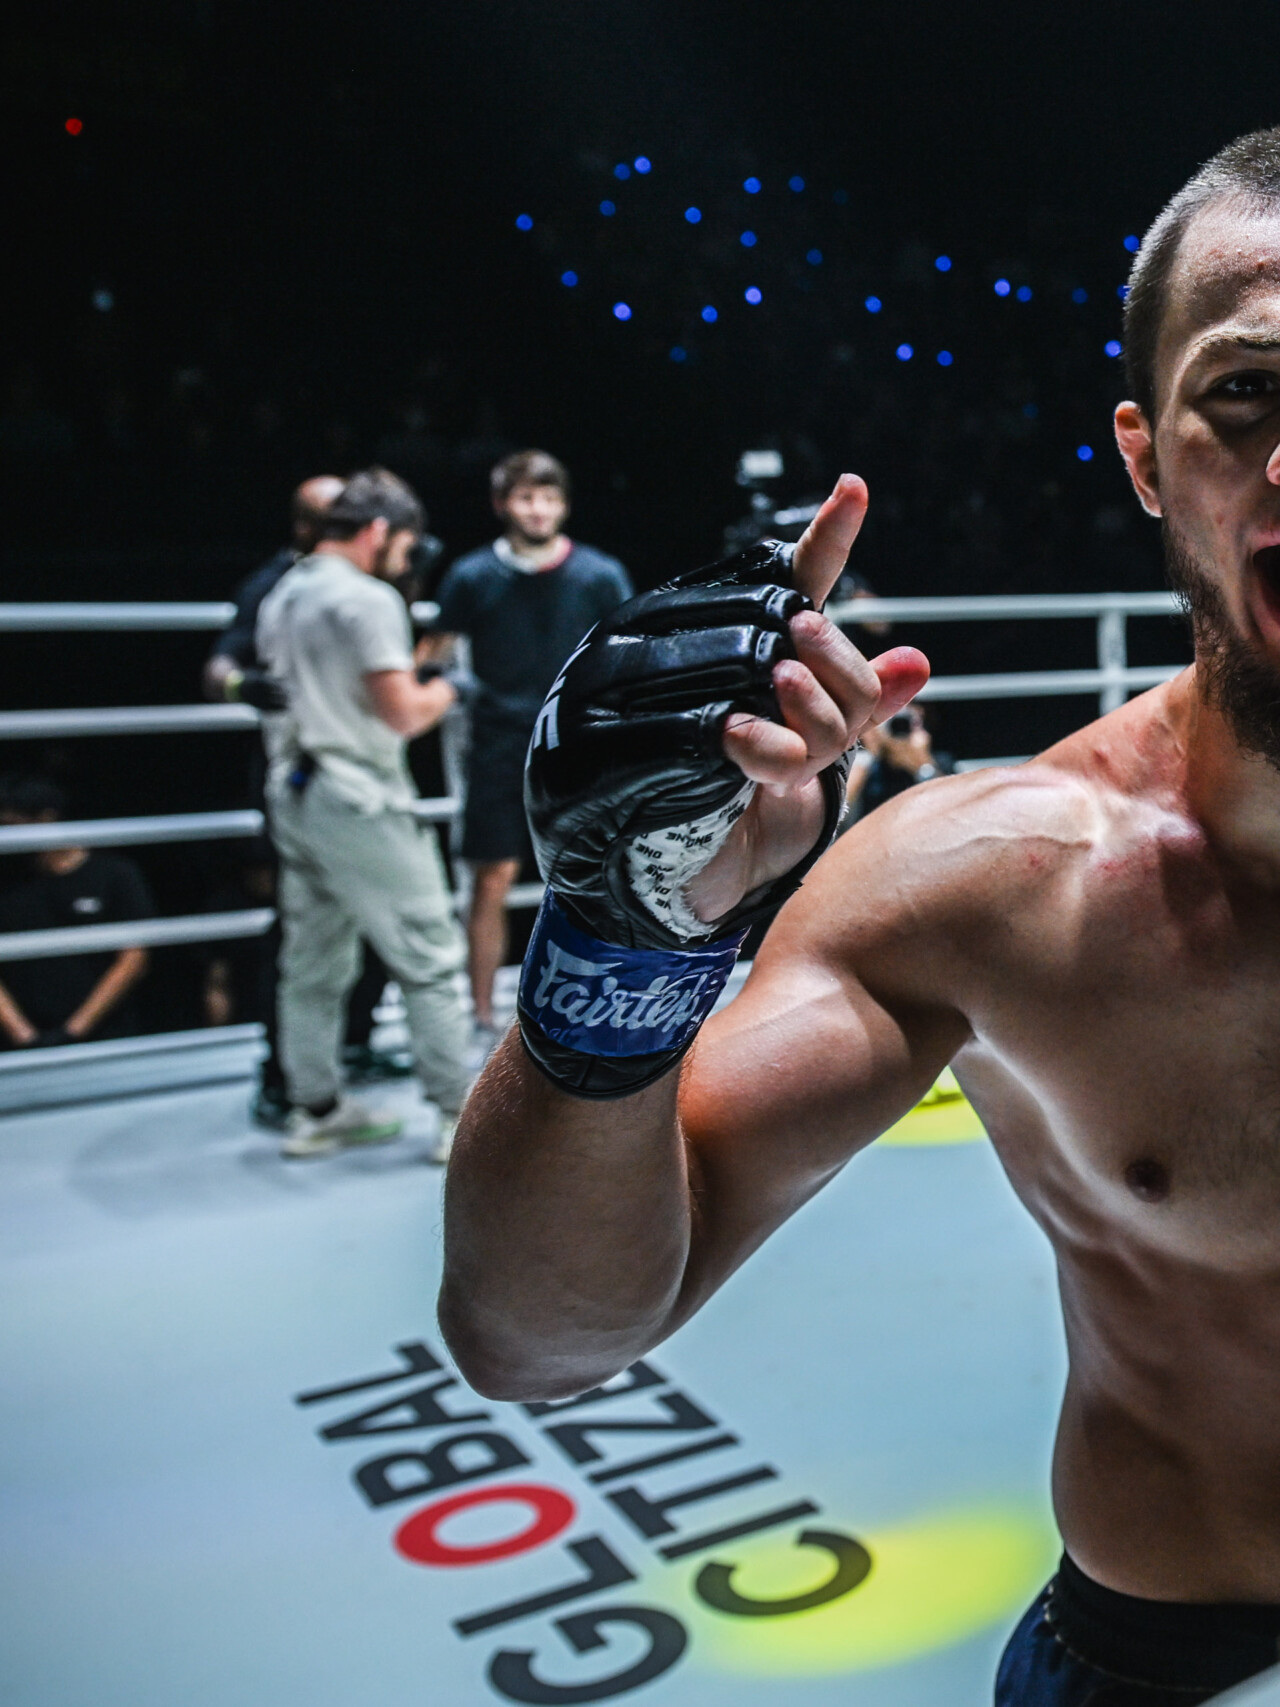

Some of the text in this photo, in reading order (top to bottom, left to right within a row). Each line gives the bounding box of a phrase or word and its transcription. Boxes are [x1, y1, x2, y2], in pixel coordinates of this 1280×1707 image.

[635, 843, 663, 859] ONE
[533, 939, 708, 1033] Fairtex
[293, 1339, 689, 1706] GLOBAL
